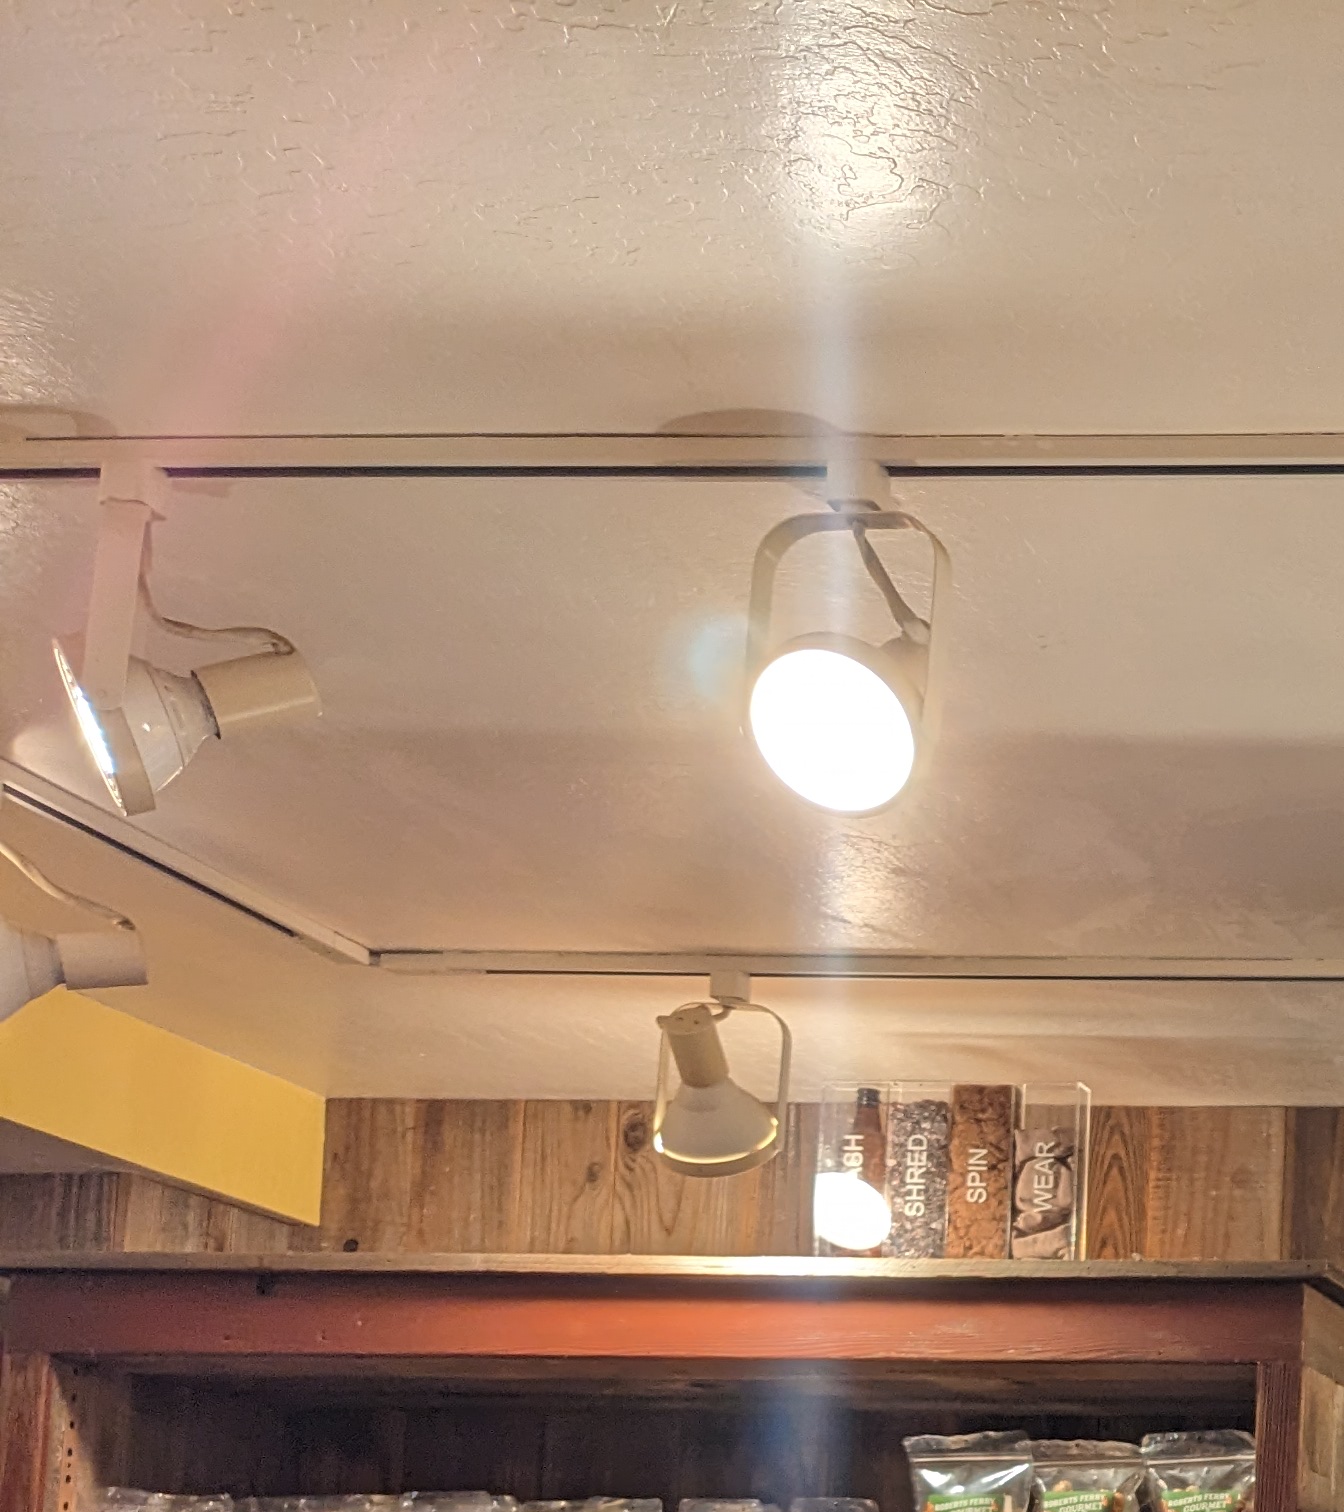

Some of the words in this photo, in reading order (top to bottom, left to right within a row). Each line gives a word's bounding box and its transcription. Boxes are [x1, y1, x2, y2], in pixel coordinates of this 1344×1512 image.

[904, 1134, 928, 1218] SHRED
[965, 1147, 990, 1204] SPIN
[1033, 1140, 1057, 1214] WEAR
